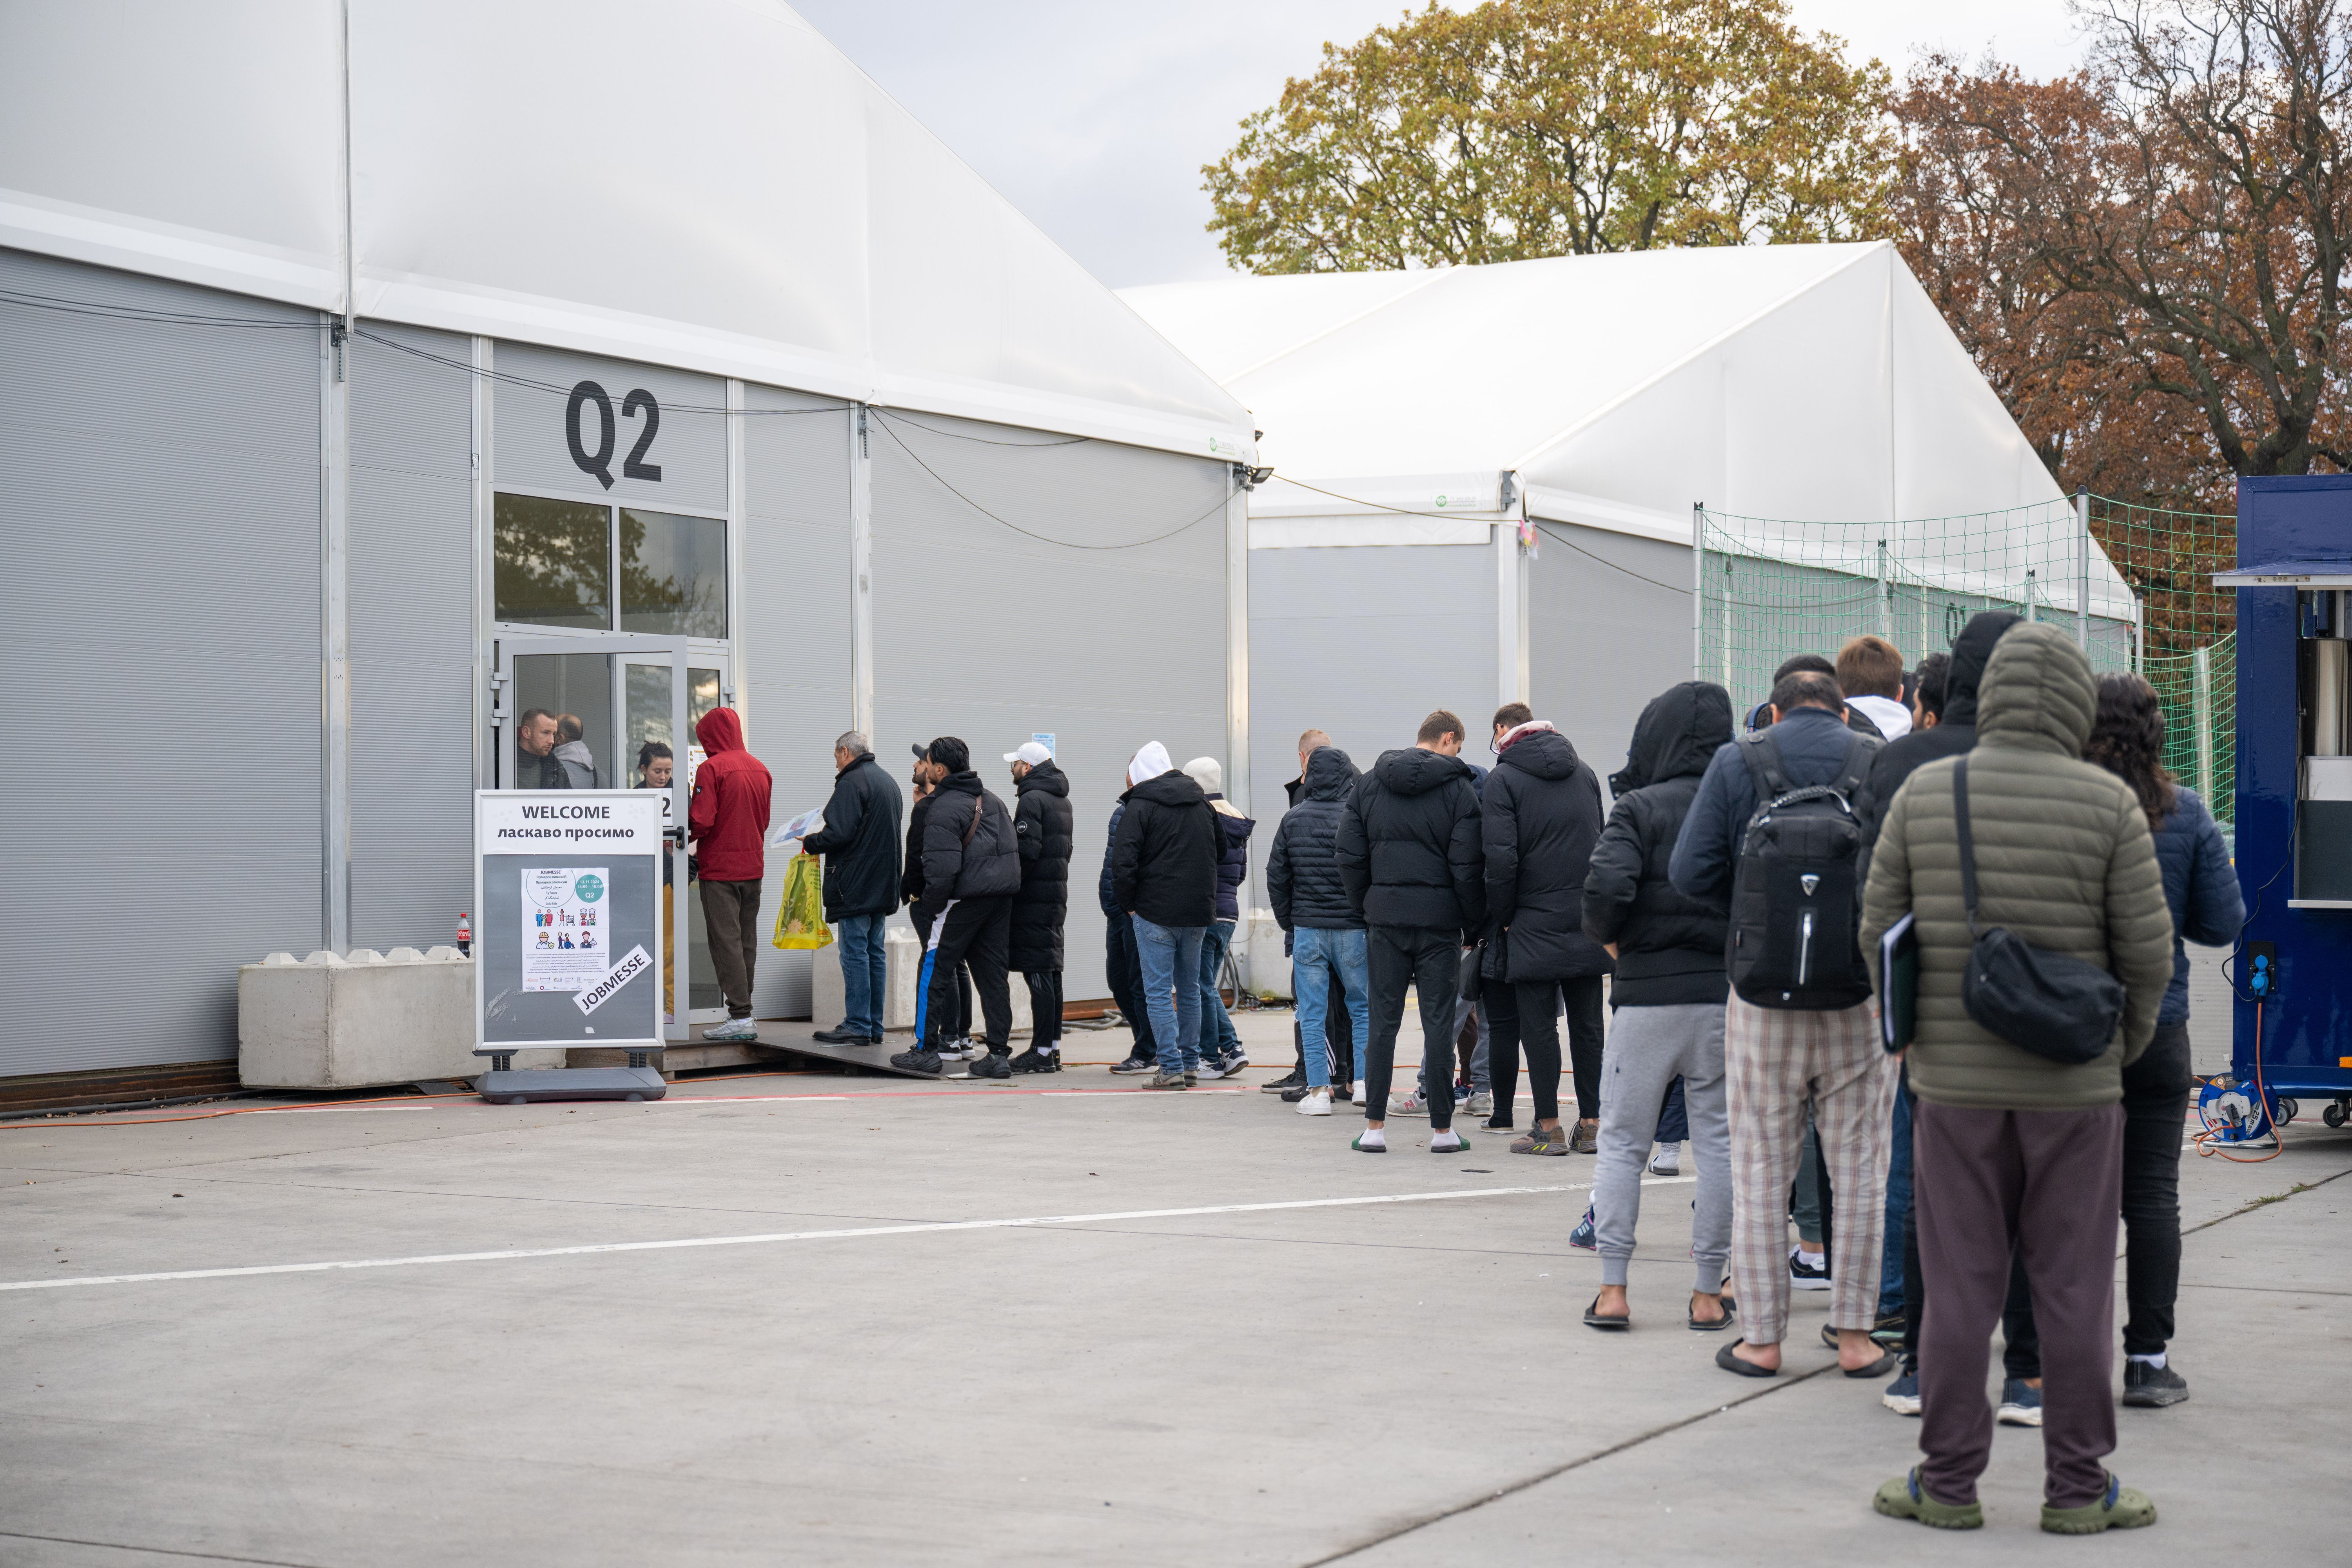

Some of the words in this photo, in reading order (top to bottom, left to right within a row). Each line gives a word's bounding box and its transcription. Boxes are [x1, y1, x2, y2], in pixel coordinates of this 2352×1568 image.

[566, 380, 661, 491] Q2
[522, 806, 610, 818] WELCOME
[497, 829, 561, 838] ласкаво
[565, 829, 634, 842] просимо
[582, 954, 645, 1010] JOBMESSE
[2252, 1110, 2259, 1120] 25
